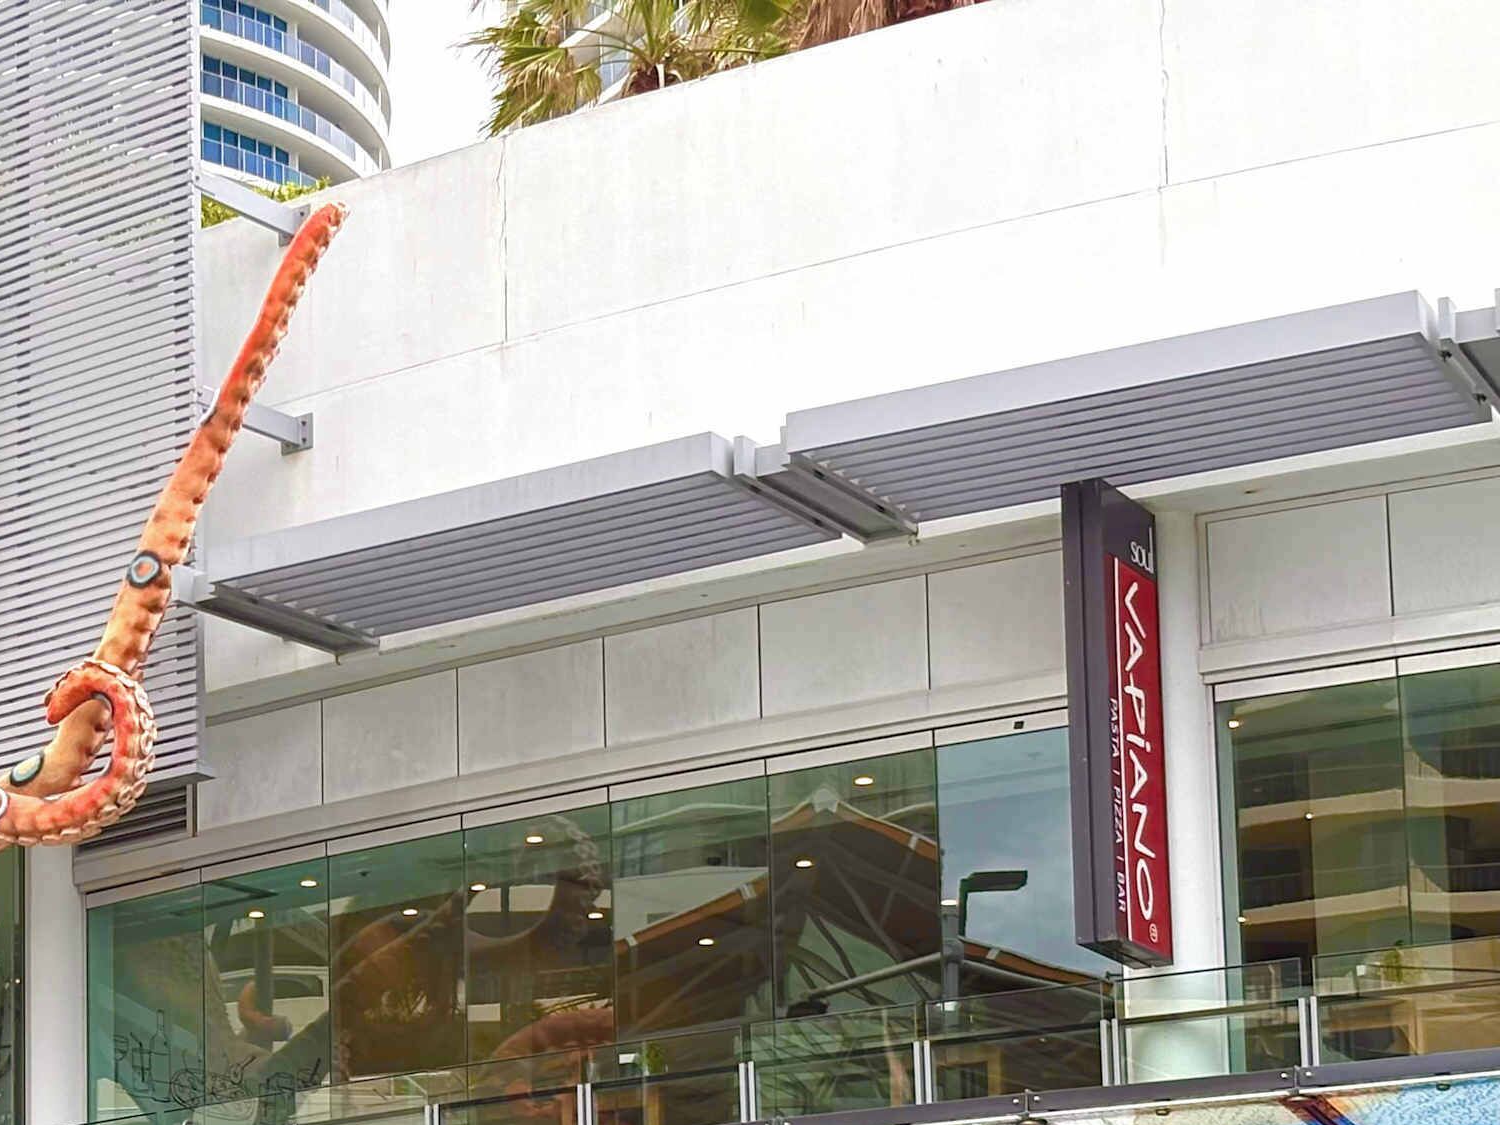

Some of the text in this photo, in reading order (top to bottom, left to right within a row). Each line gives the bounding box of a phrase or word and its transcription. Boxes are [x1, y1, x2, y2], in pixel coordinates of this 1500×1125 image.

[1130, 527, 1154, 574] soul
[1109, 698, 1127, 913] PASTA PIZZA BAR
